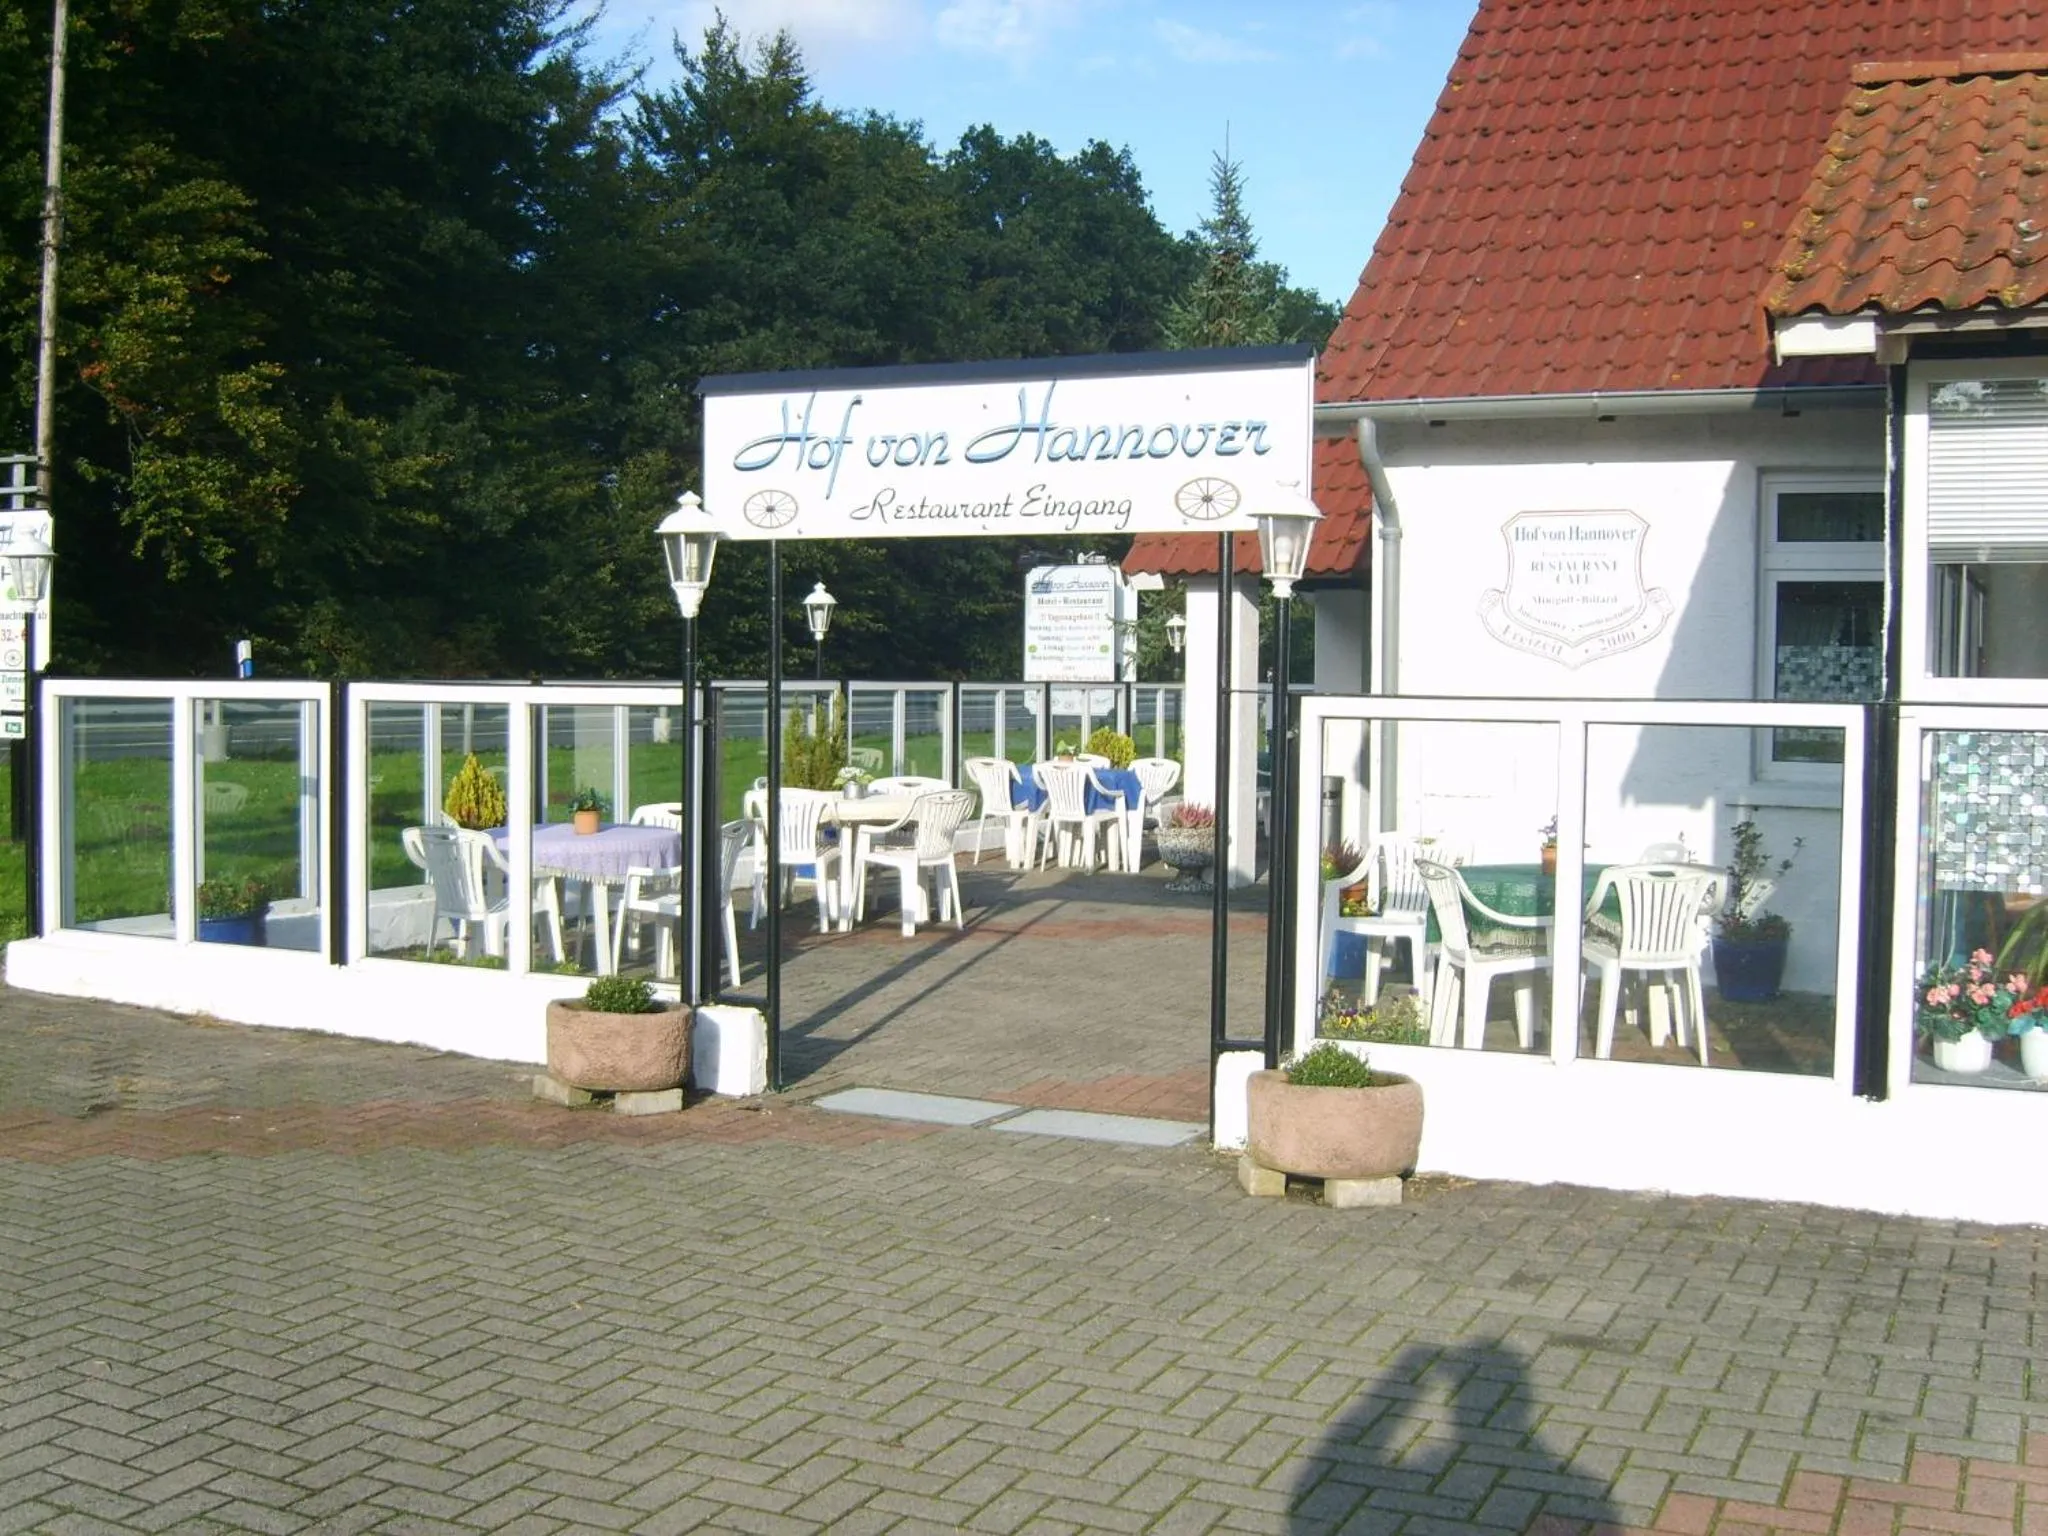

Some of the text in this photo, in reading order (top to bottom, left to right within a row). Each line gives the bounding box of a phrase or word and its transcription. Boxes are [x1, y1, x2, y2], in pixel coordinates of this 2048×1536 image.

[733, 377, 1272, 500] Hof von Hannover
[850, 483, 1134, 531] Restaurant Eingang
[1514, 525, 1638, 542] Hof von Hannover
[1531, 560, 1618, 572] RESTAURANT
[1598, 631, 1636, 650] 2000
